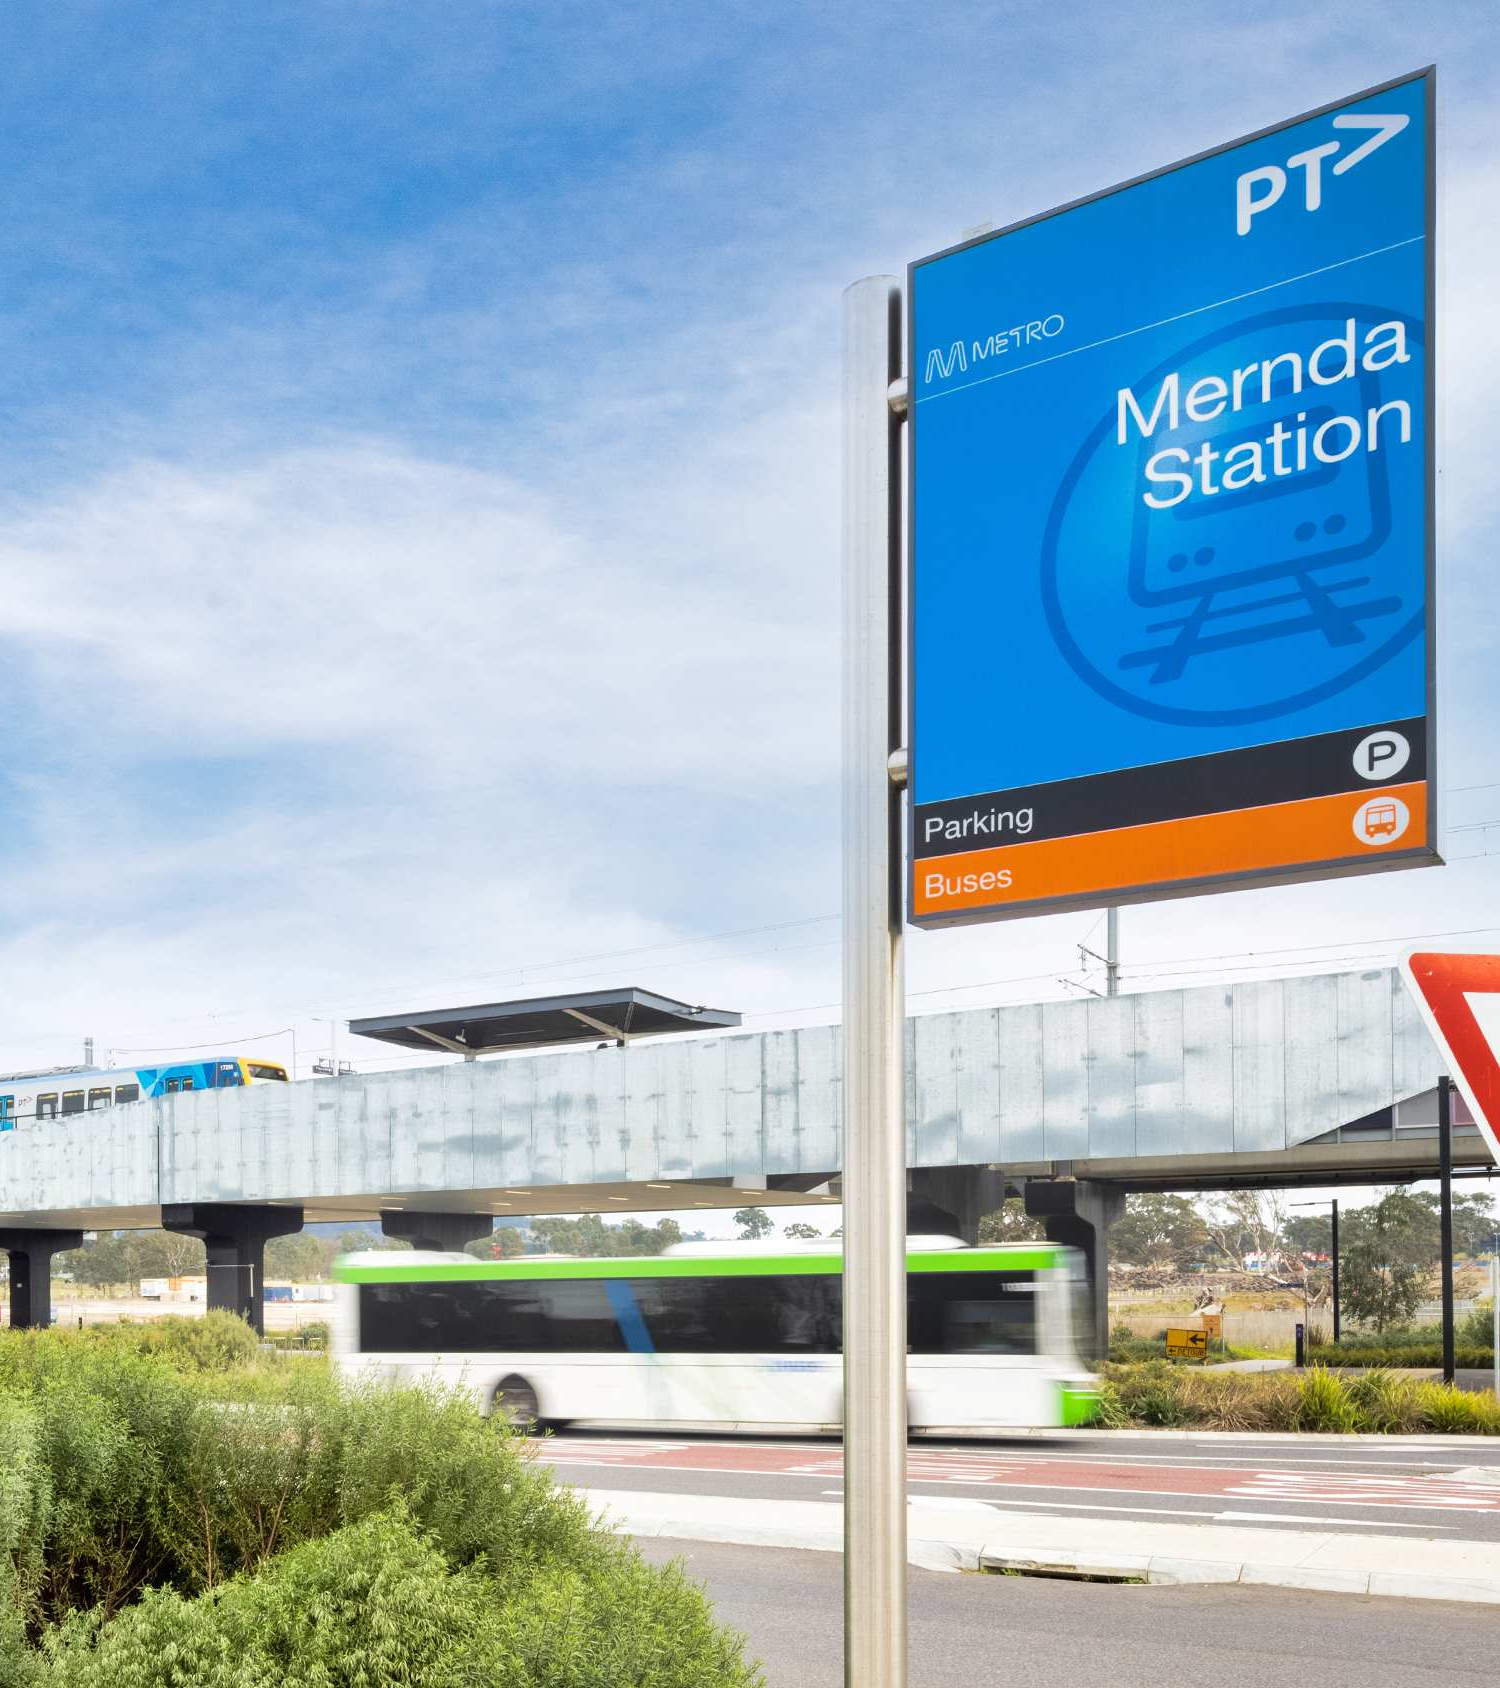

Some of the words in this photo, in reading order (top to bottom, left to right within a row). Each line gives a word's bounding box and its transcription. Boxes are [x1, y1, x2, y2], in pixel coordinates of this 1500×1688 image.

[972, 314, 1065, 362] METRO
[1117, 318, 1411, 445] Mernda
[1143, 400, 1411, 509] Station
[1368, 740, 1397, 772] P
[925, 807, 1033, 843] Parking
[925, 869, 1013, 898] Buses
